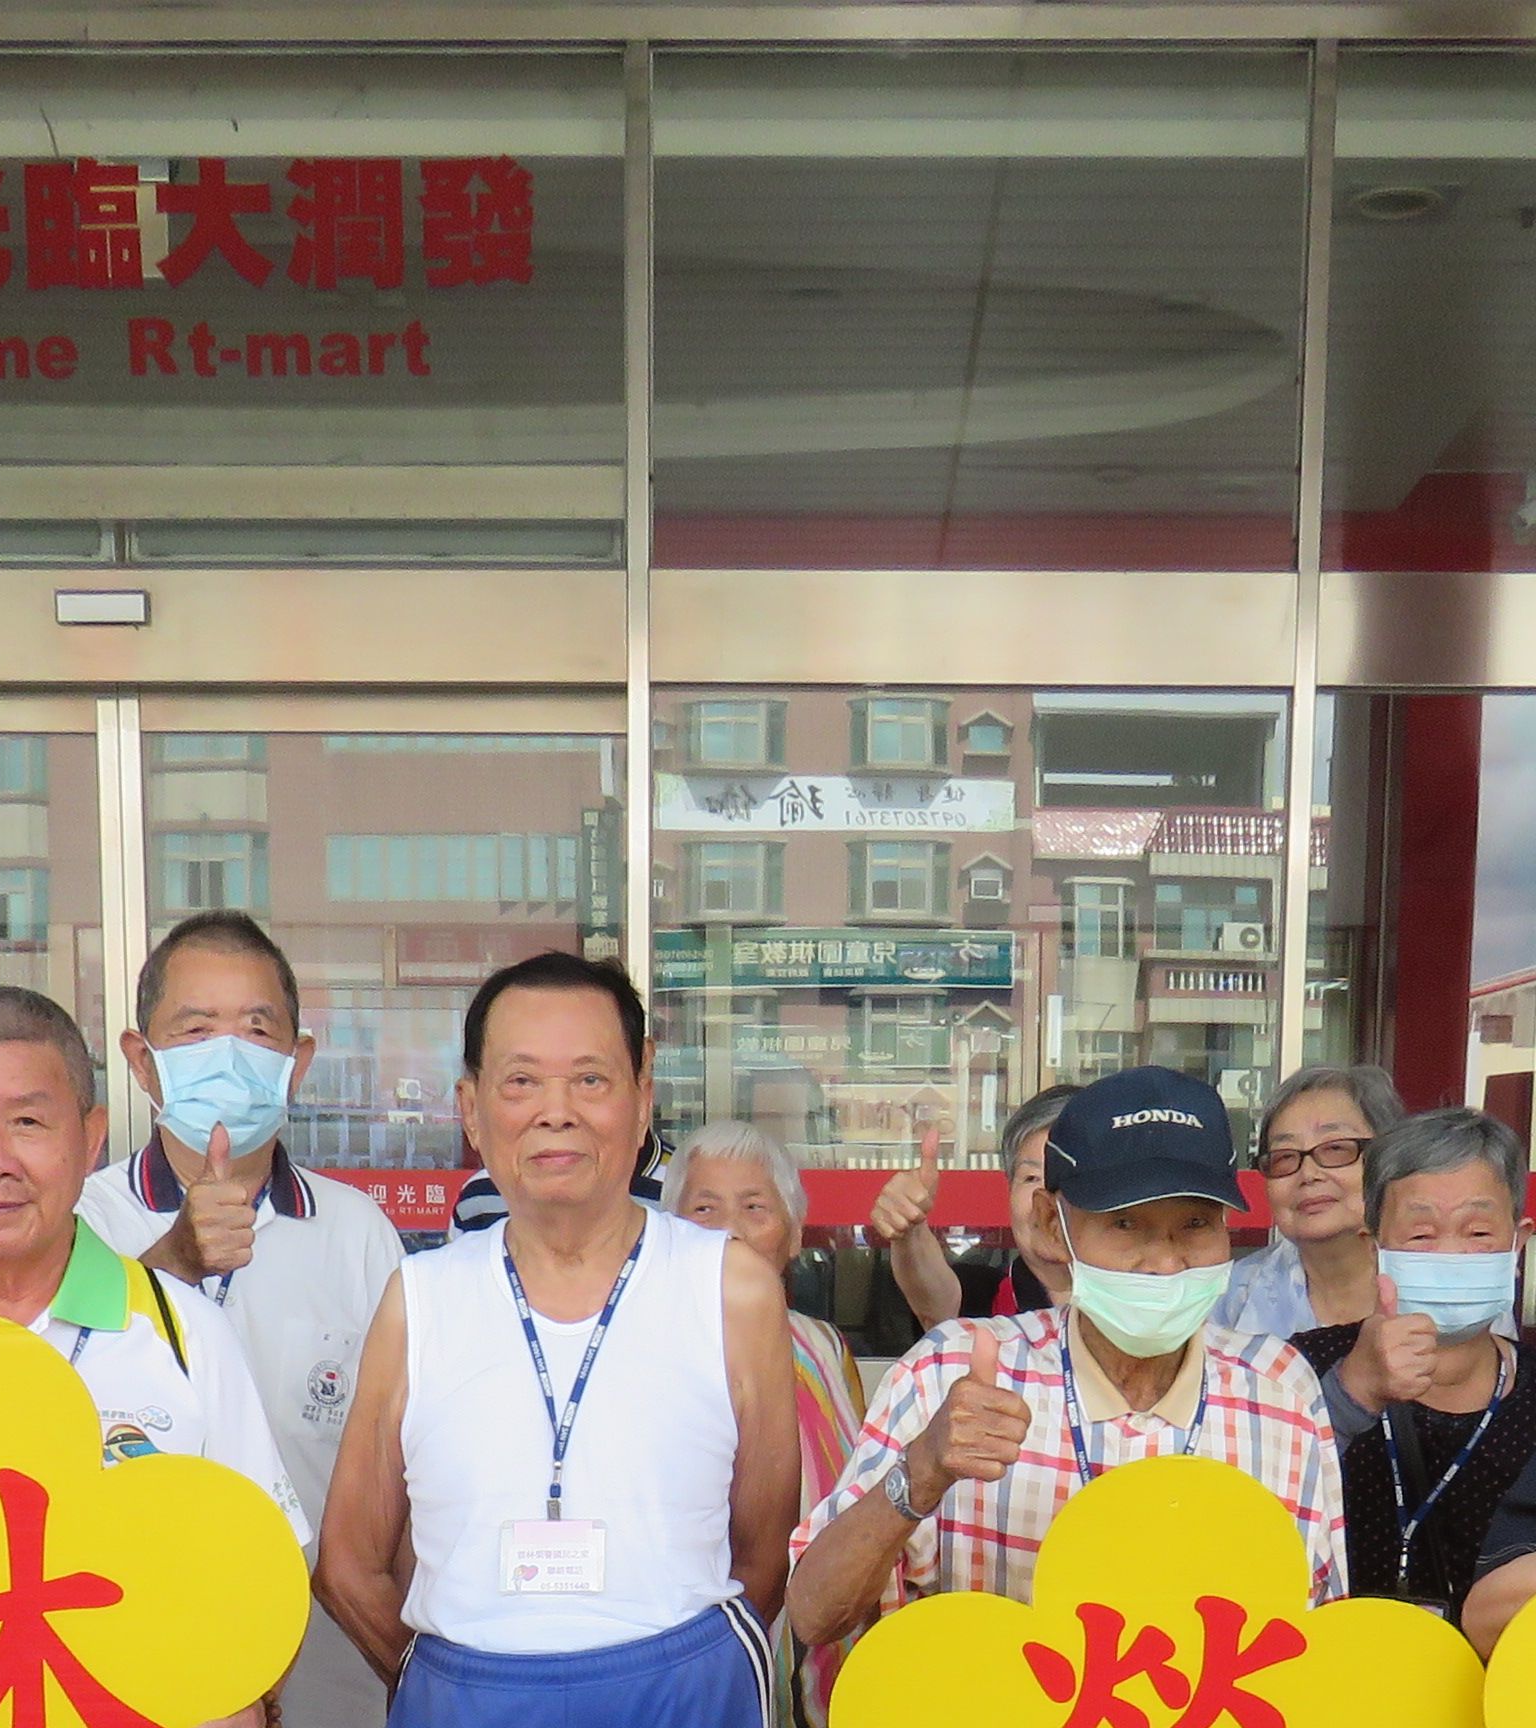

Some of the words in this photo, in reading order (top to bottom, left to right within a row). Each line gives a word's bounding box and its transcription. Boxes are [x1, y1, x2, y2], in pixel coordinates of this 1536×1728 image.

[127, 316, 432, 377] Rt-mart
[1111, 1109, 1204, 1129] HONDA
[350, 1183, 446, 1205] 迎光臨
